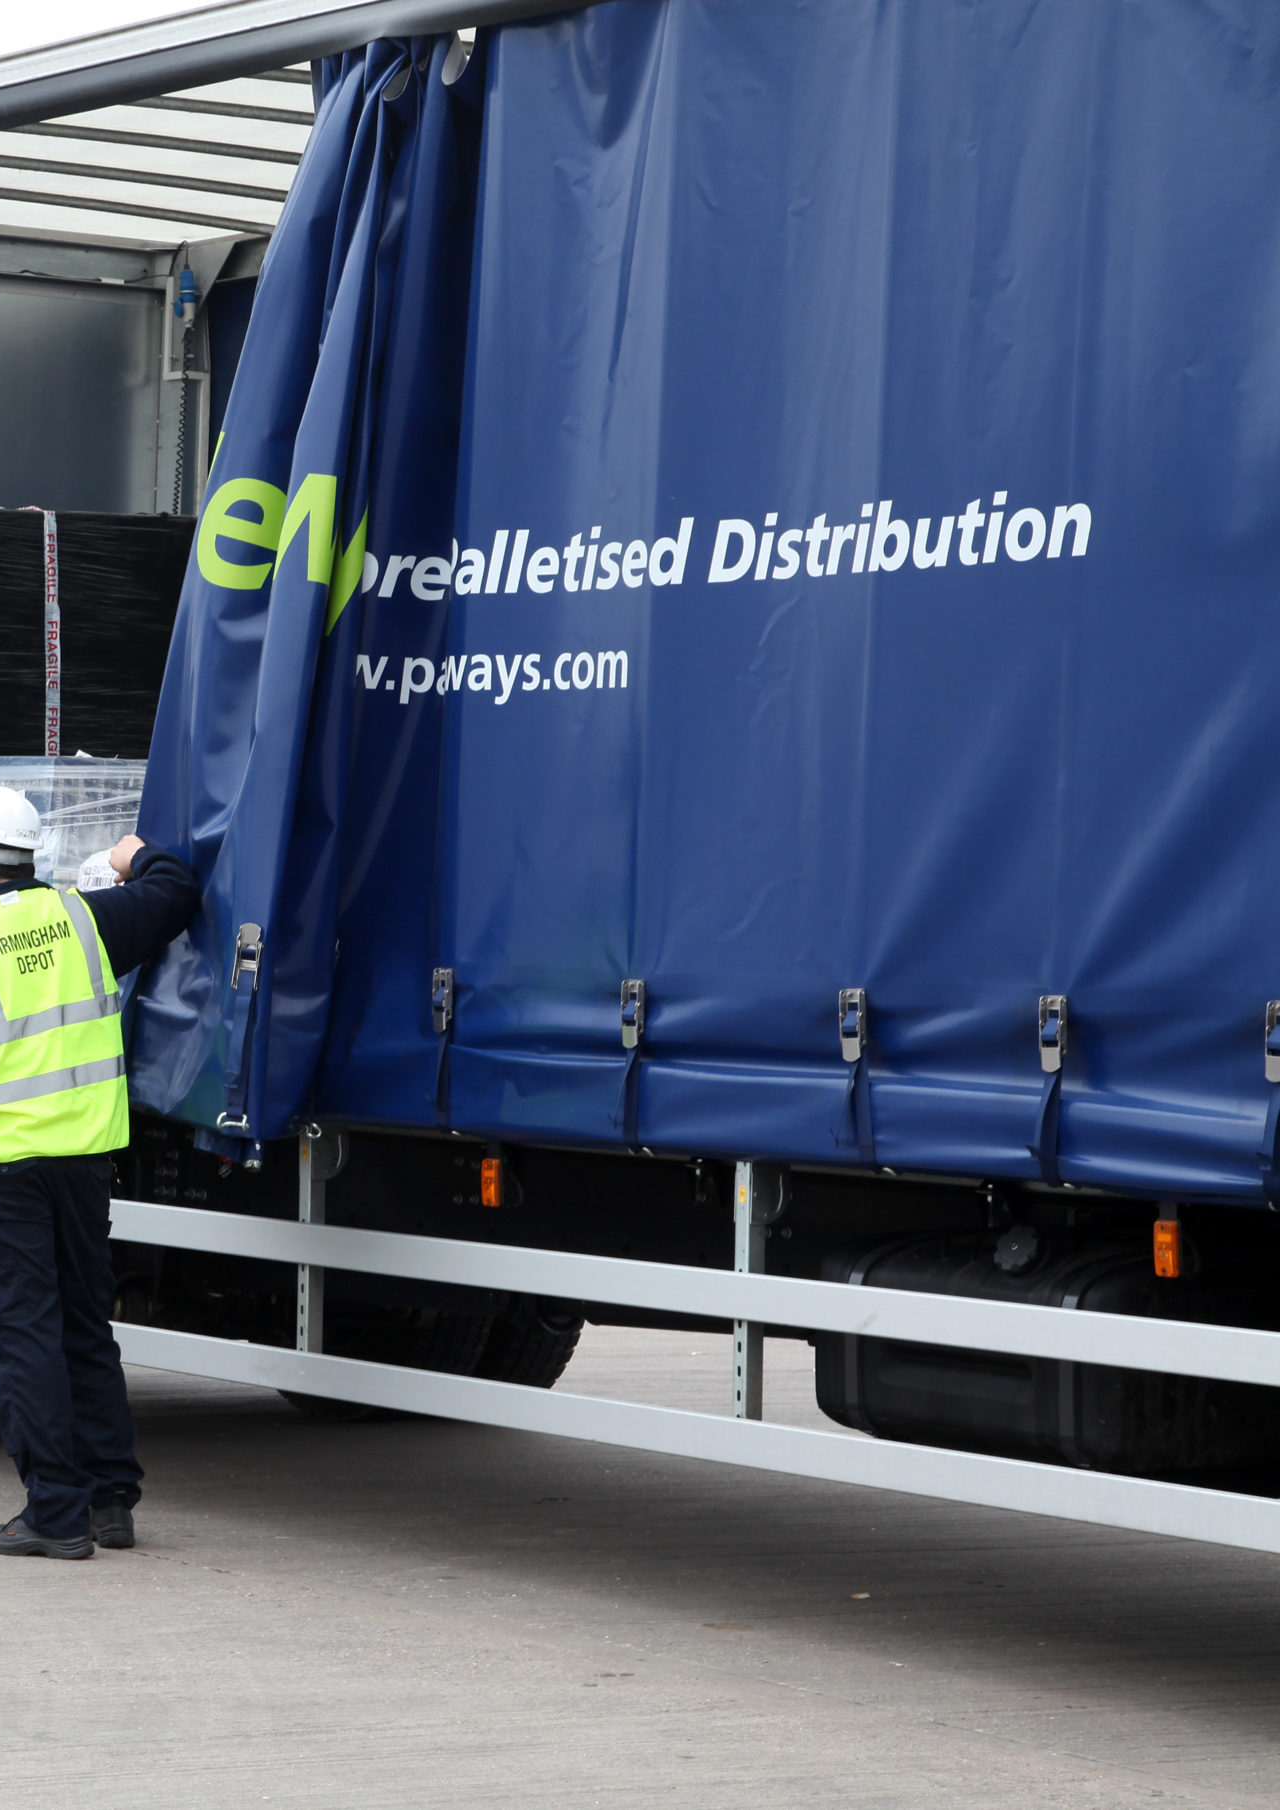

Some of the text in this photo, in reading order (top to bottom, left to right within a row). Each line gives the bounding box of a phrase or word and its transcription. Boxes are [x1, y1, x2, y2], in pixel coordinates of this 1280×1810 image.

[47, 533, 57, 603] FRAGILE
[707, 490, 1093, 584] Distribution
[47, 620, 58, 690] FRAGILE
[16, 949, 55, 975] DEPOT
